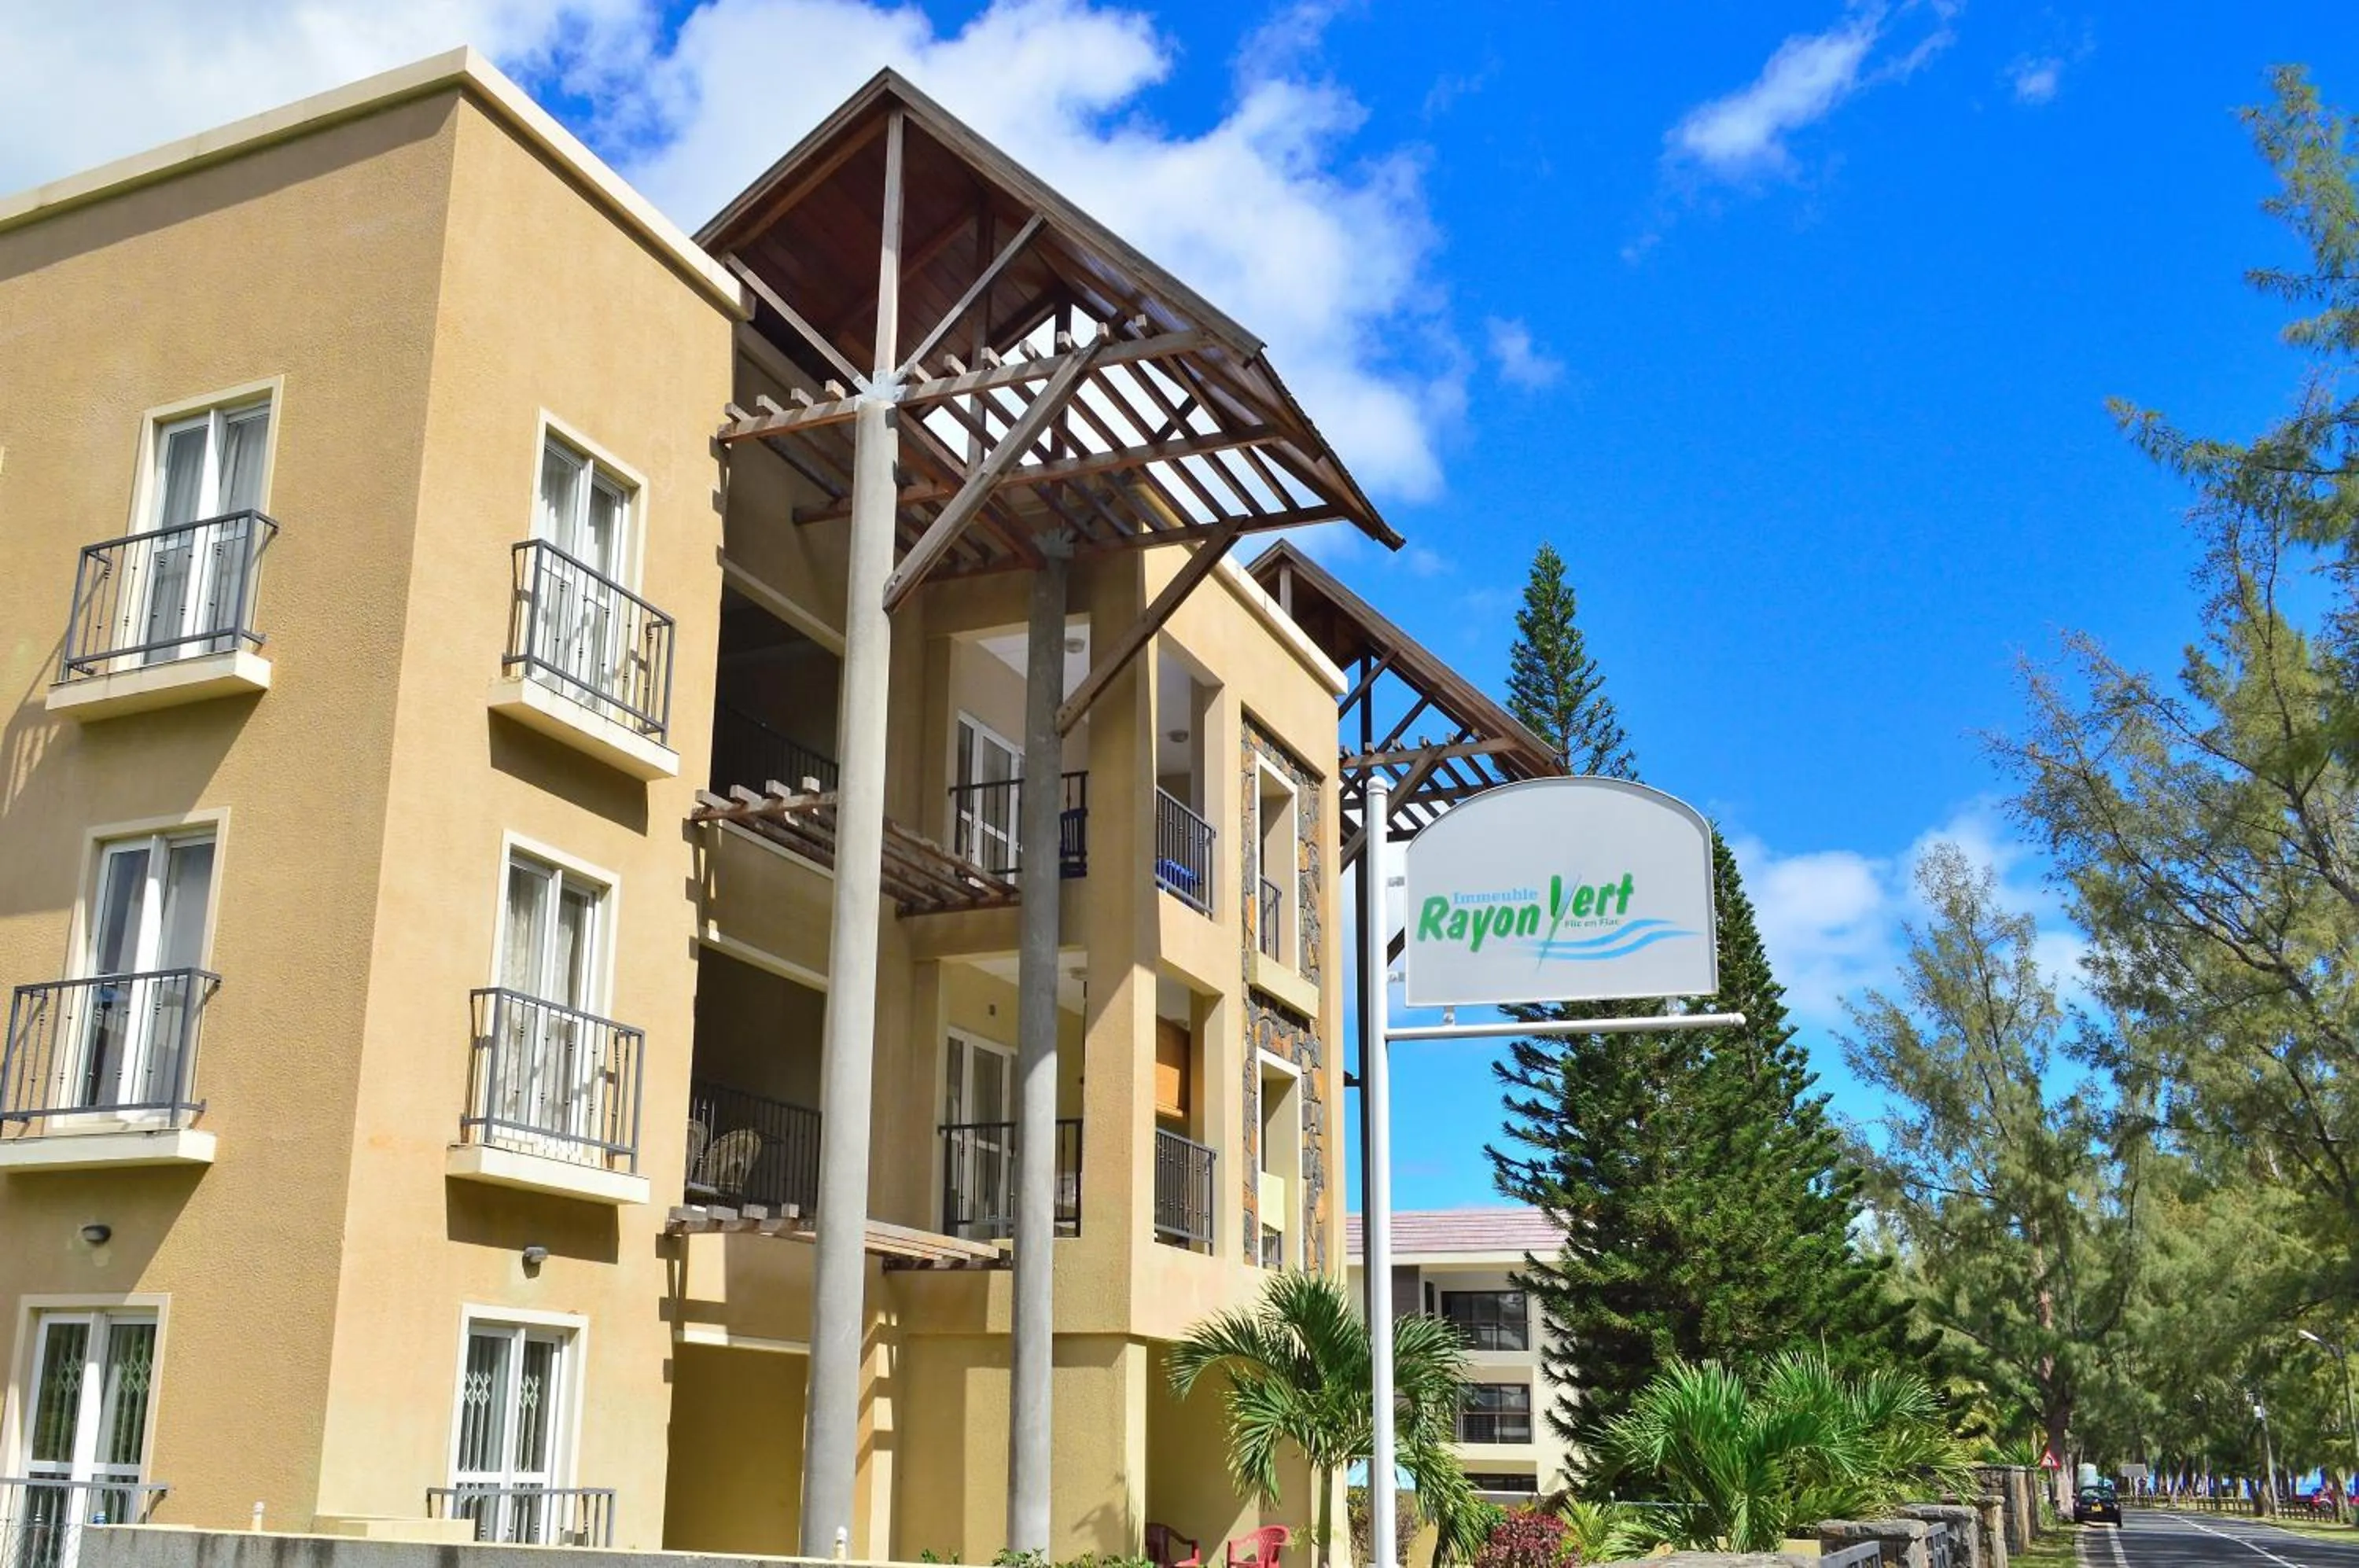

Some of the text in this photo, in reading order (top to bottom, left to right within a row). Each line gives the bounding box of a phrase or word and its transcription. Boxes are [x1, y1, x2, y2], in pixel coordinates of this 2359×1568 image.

[1416, 871, 1634, 952] Rayon Vert
[1454, 888, 1537, 904] Immeuble
